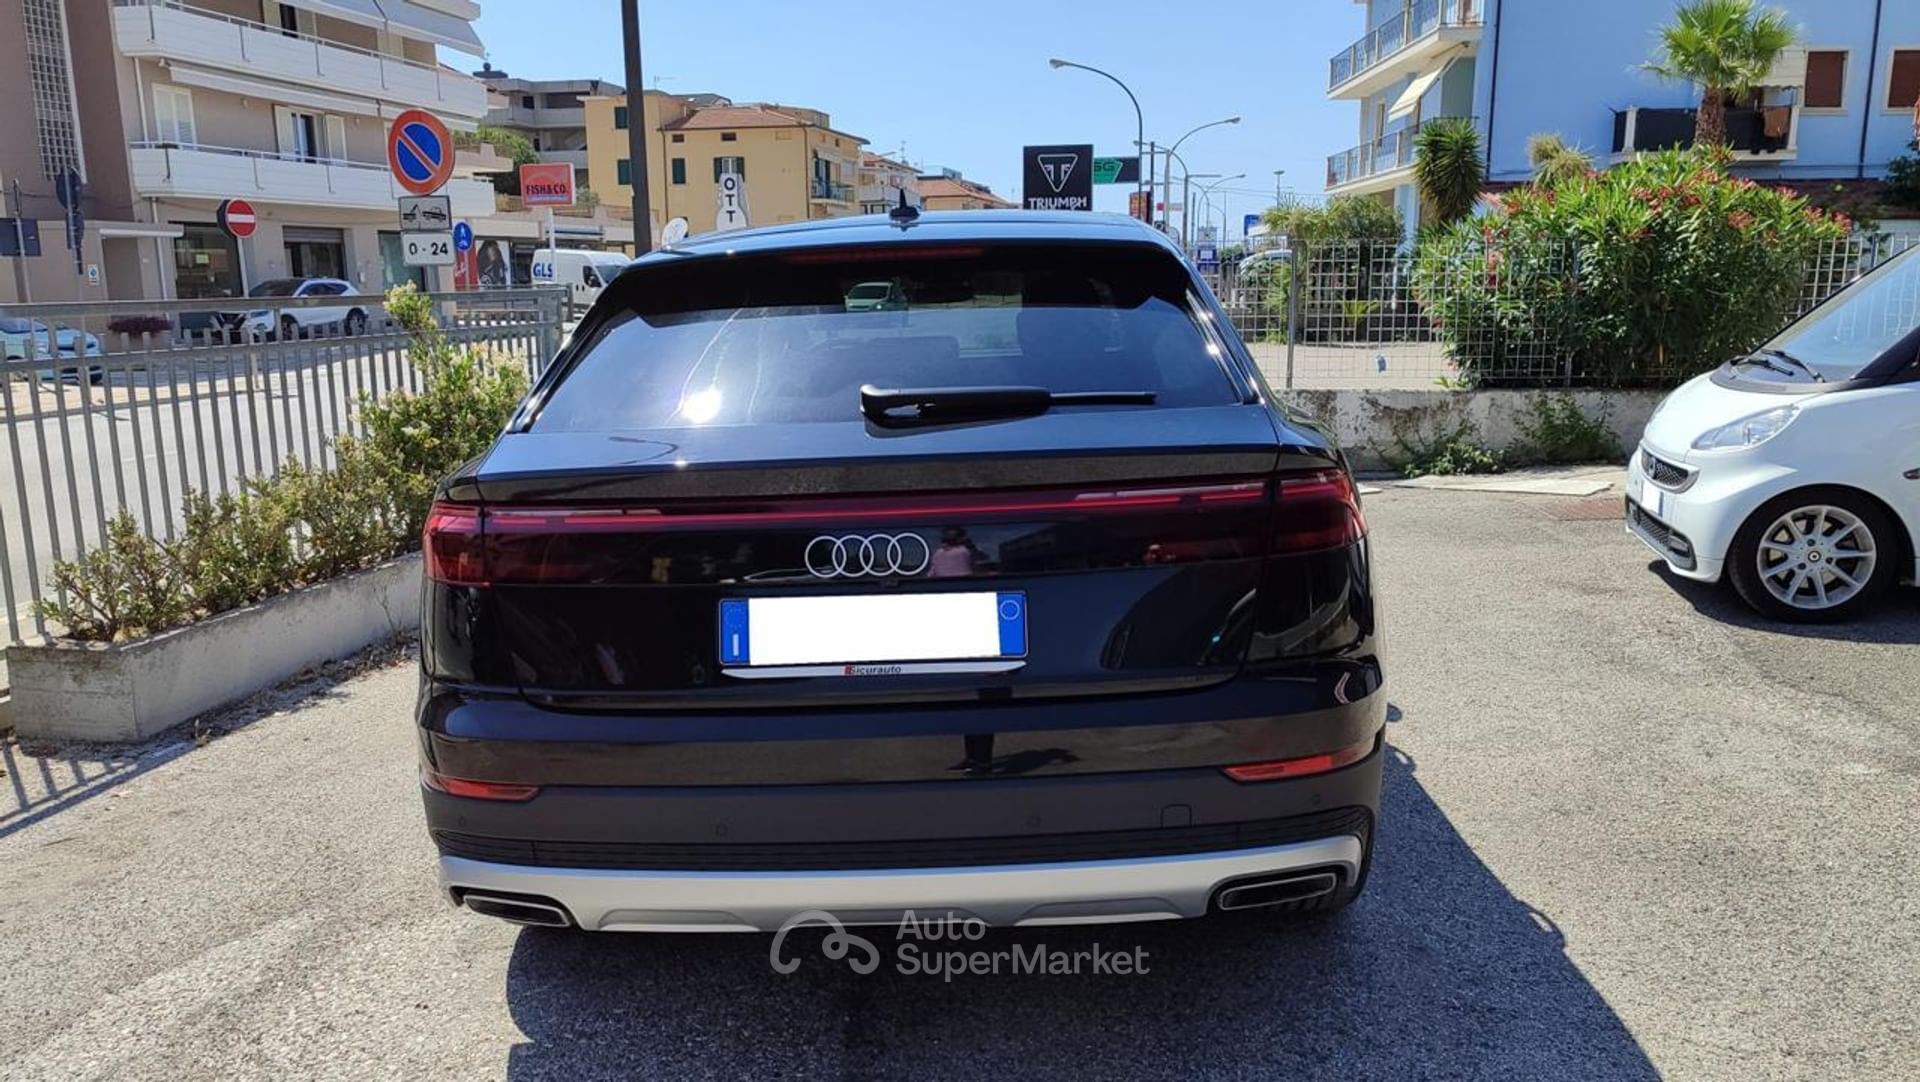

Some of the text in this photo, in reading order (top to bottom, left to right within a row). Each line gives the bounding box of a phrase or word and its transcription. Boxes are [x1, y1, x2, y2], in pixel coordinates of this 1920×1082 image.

[724, 177, 737, 223] OTT
[1028, 196, 1087, 210] TRIUMPH
[409, 242, 418, 255] 0
[431, 242, 448, 256] 24
[533, 262, 553, 278] GLS
